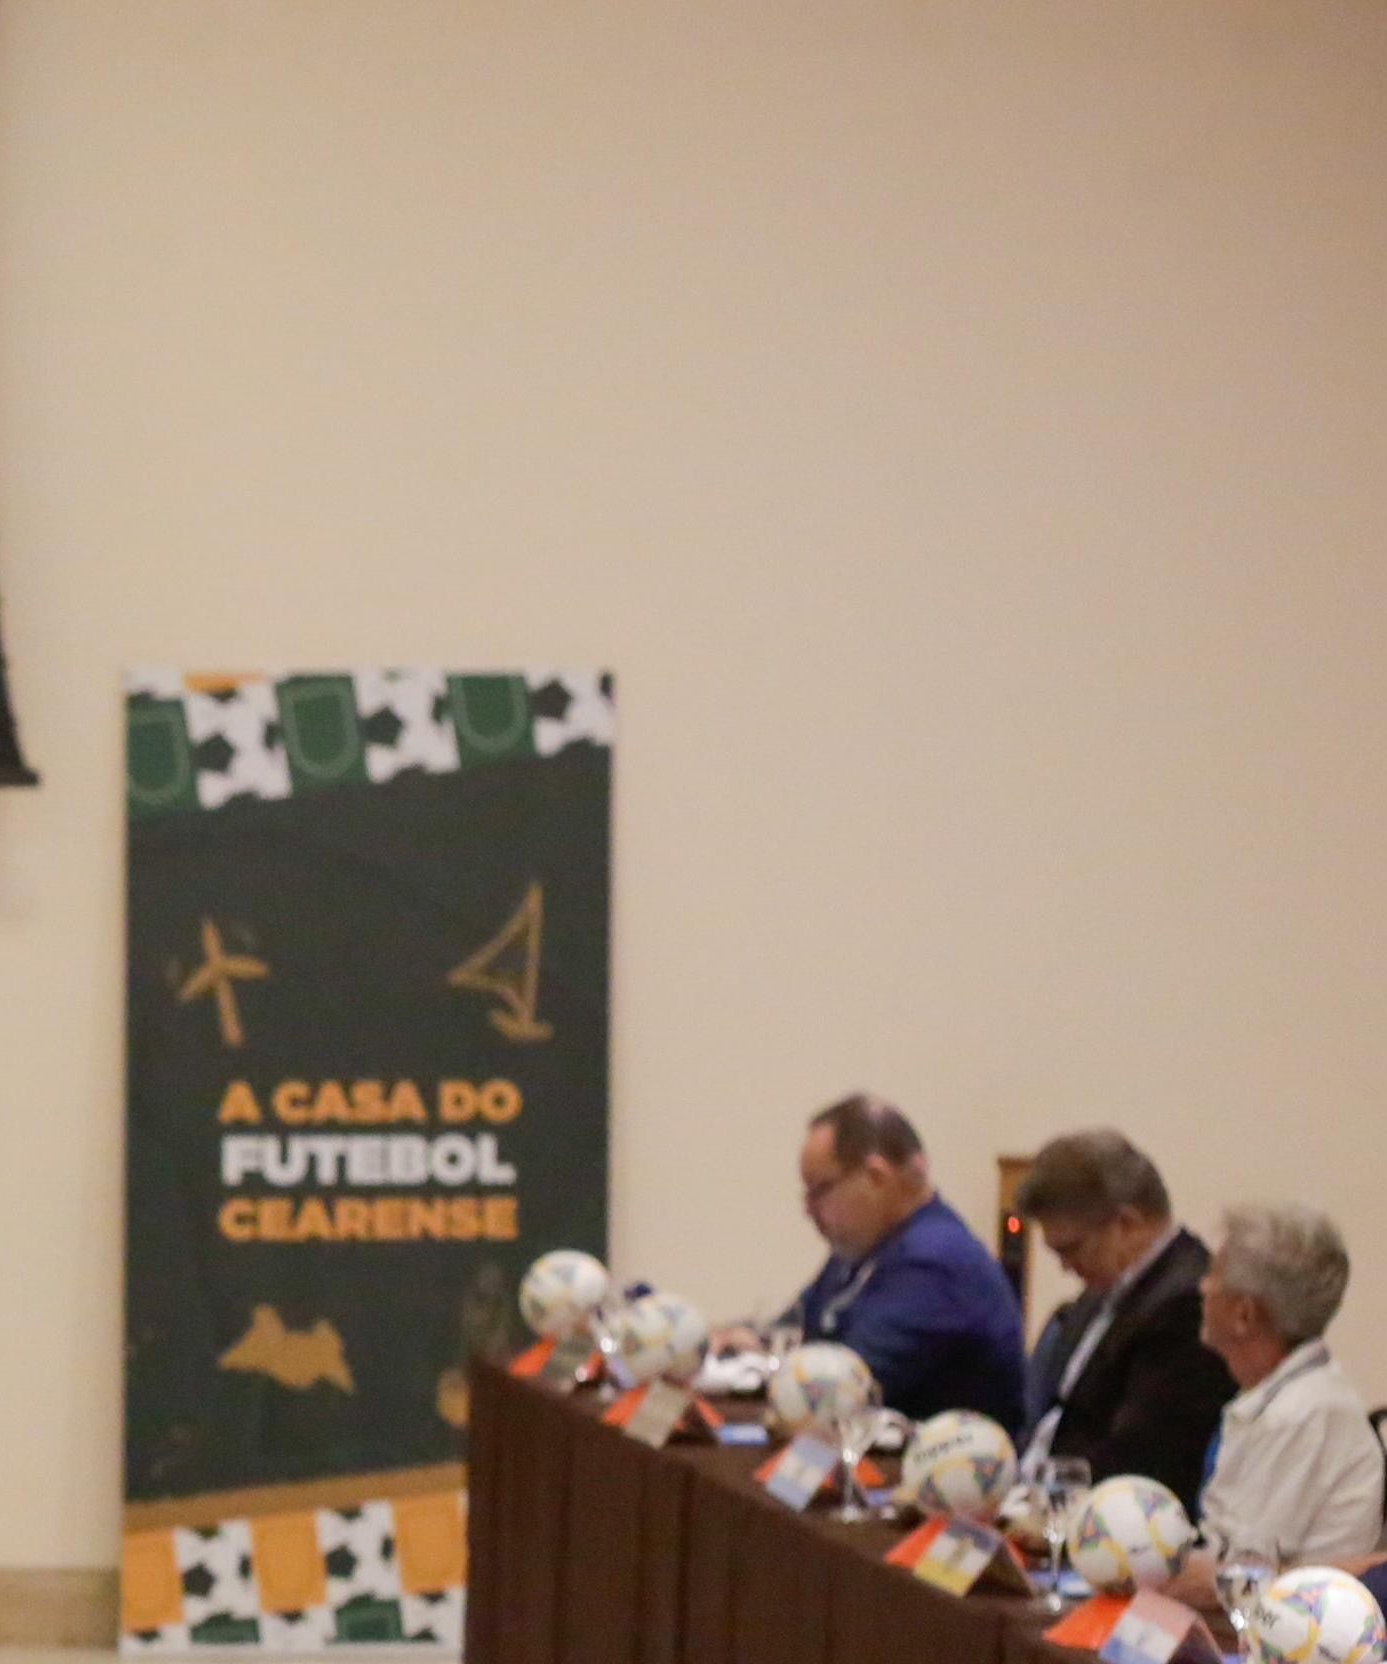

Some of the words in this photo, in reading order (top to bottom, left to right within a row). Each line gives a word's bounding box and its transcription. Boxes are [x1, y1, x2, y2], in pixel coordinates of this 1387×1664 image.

[220, 1080, 261, 1124] A
[273, 1079, 427, 1125] CASA
[438, 1079, 523, 1125] DO
[221, 1132, 517, 1186] FUTEBOL
[219, 1198, 519, 1242] CEARENSE
